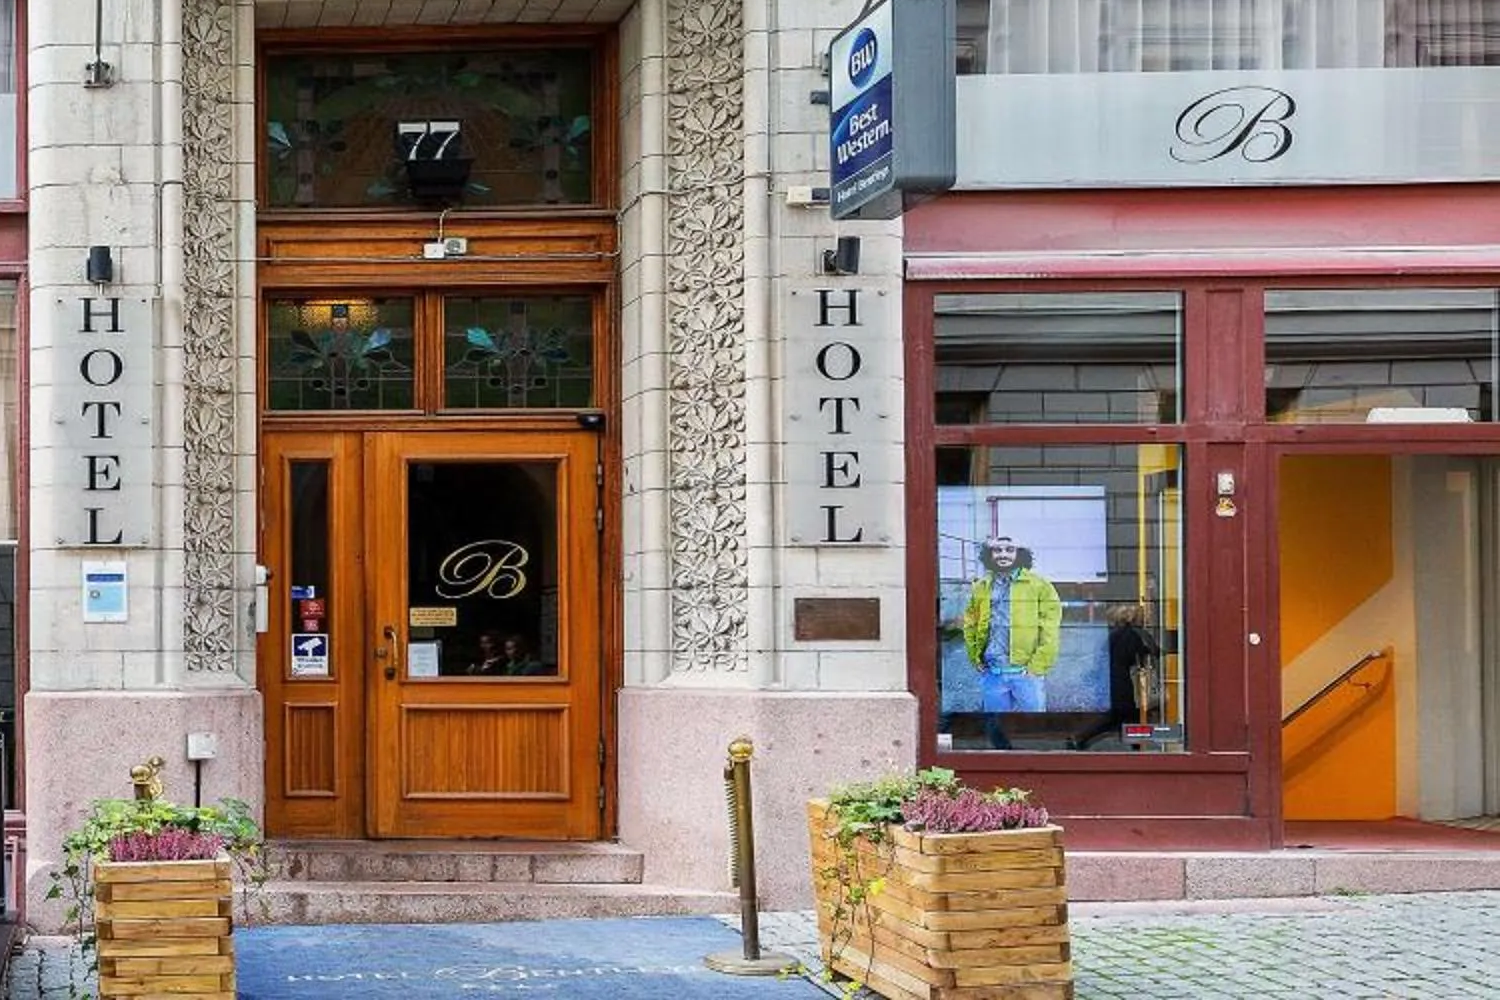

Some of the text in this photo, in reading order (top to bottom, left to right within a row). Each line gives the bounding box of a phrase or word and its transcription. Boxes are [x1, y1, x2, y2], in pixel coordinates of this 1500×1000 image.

[851, 42, 874, 77] BW
[398, 121, 460, 161] 77
[850, 103, 878, 136] Best
[1169, 85, 1297, 164] B
[78, 297, 125, 545] HOTEL
[813, 289, 863, 543] HOTEL
[436, 539, 529, 599] B
